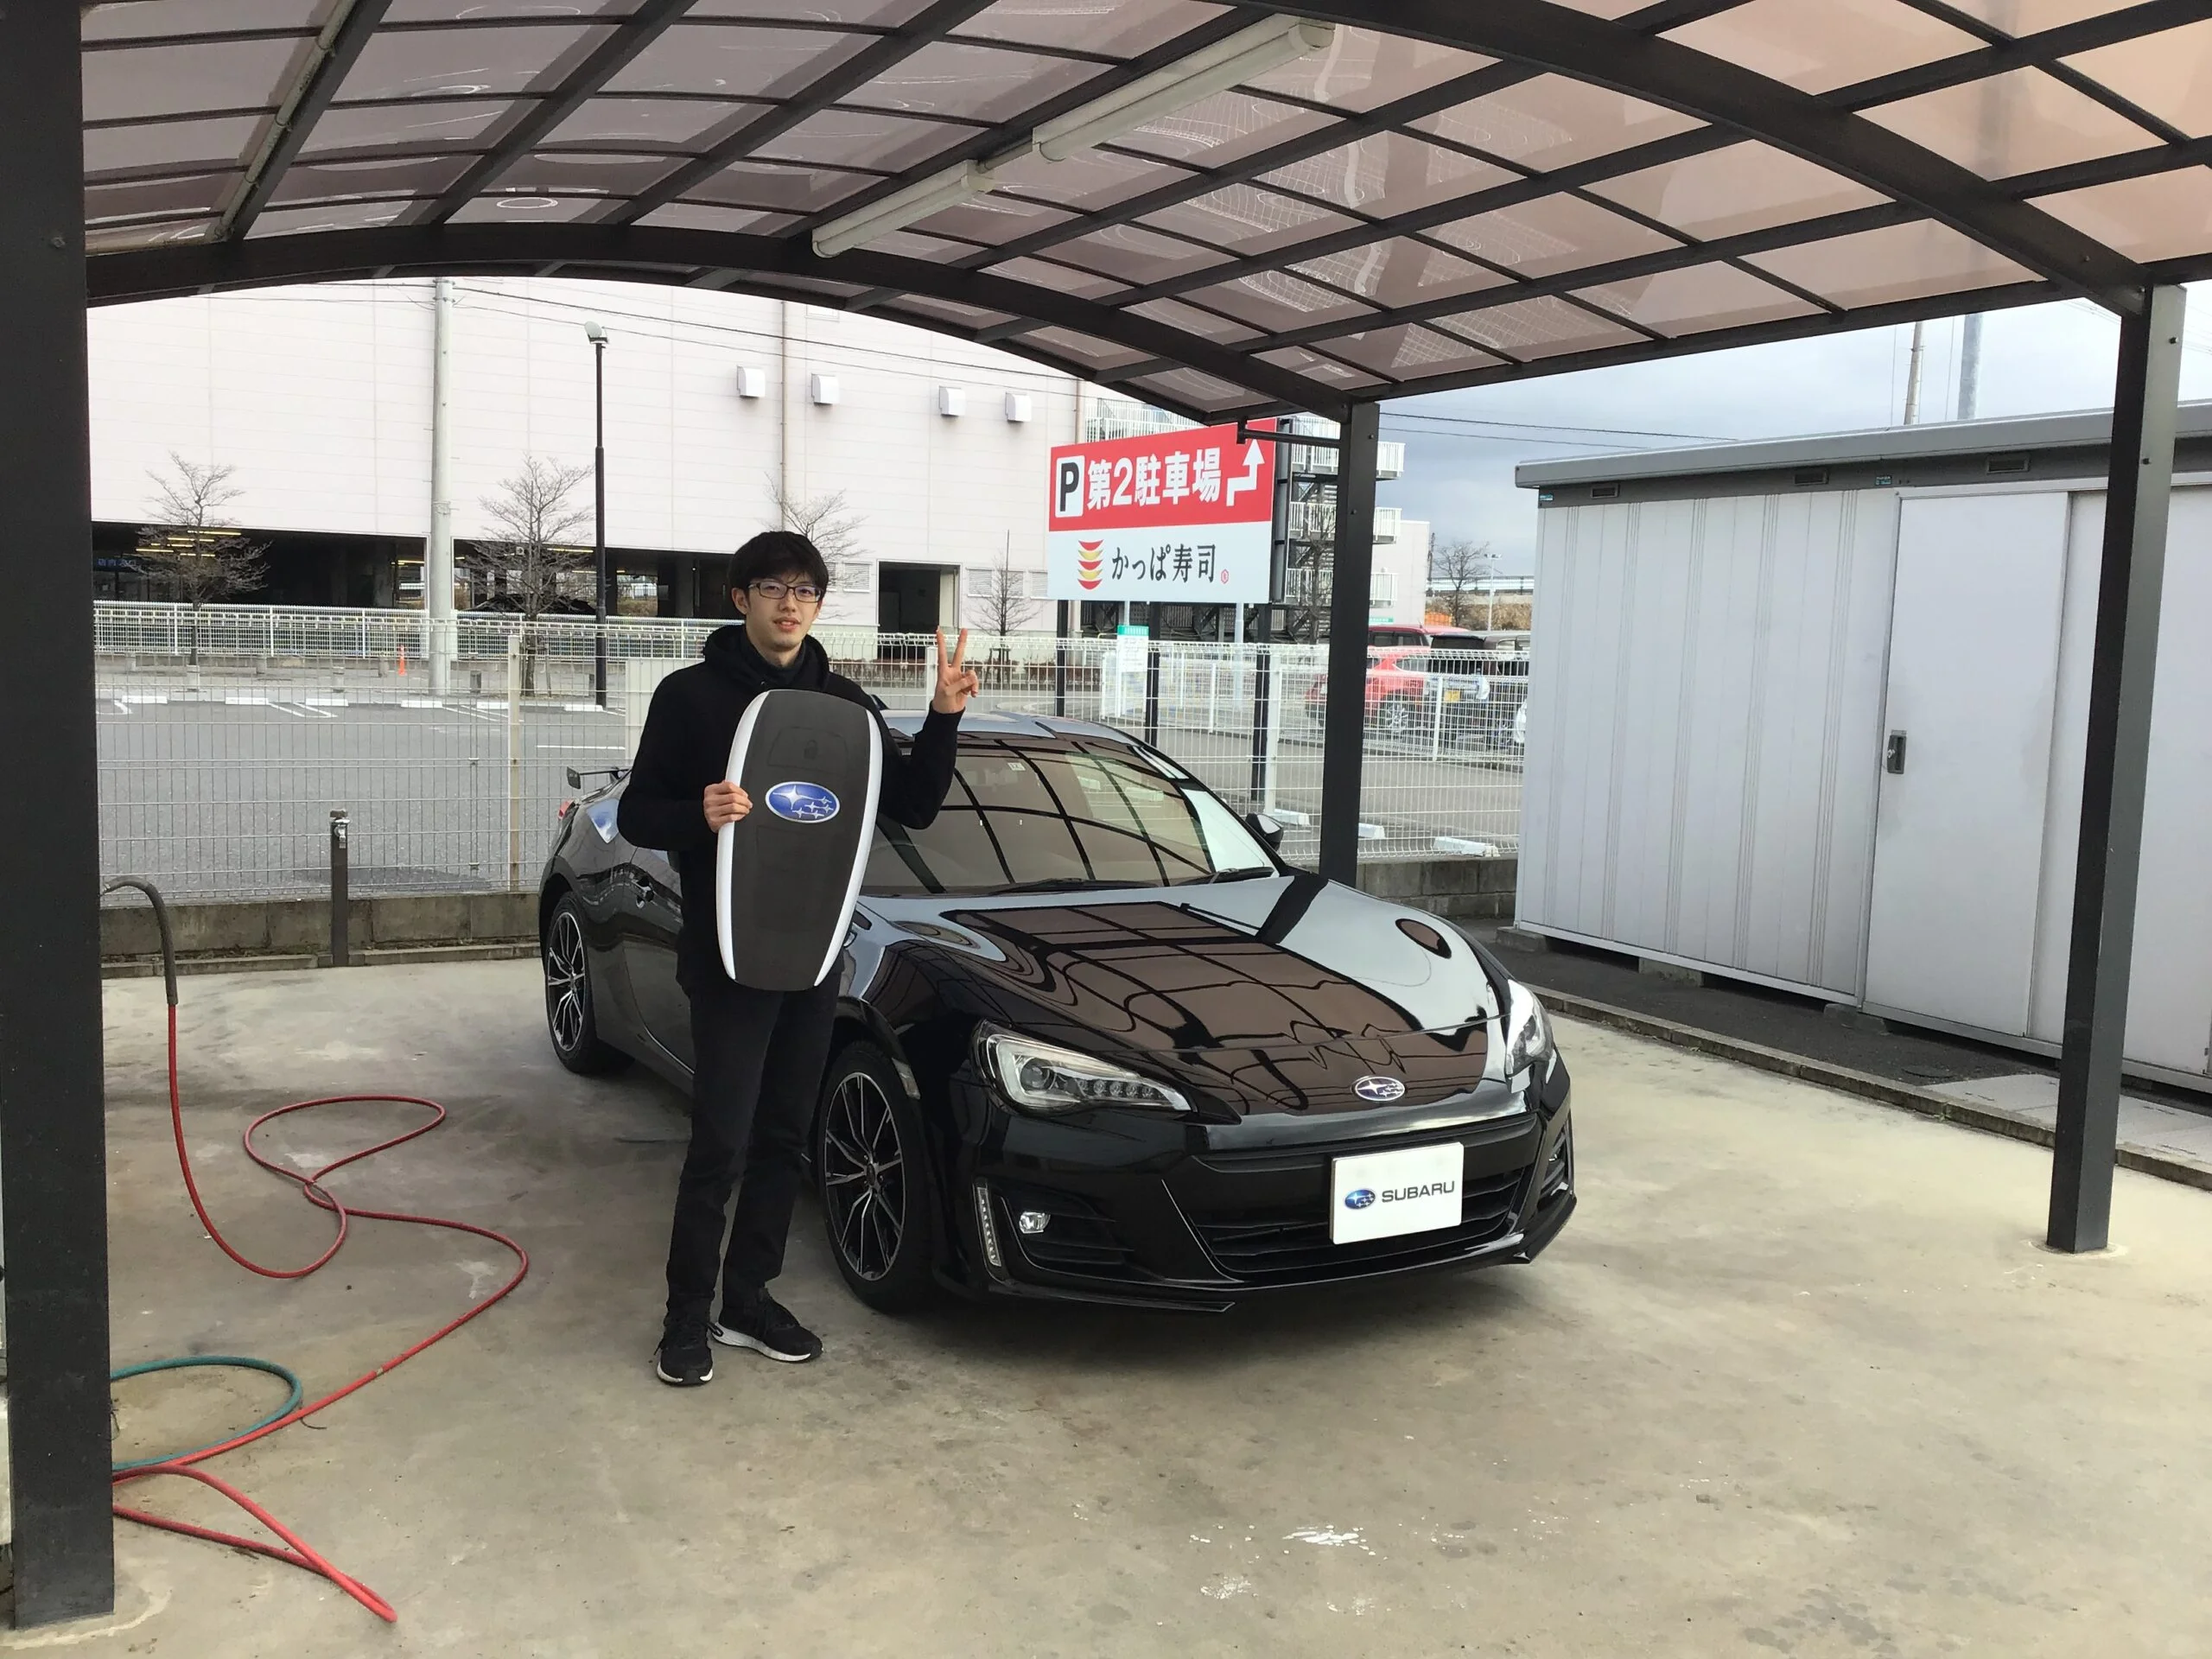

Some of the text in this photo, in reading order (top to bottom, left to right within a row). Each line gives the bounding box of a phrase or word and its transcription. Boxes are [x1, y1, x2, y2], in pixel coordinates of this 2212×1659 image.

[1059, 447, 1222, 512] P 第2駐車場
[1111, 543, 1217, 583] かっぱ寿司
[1381, 1180, 1456, 1204] SUBARU
